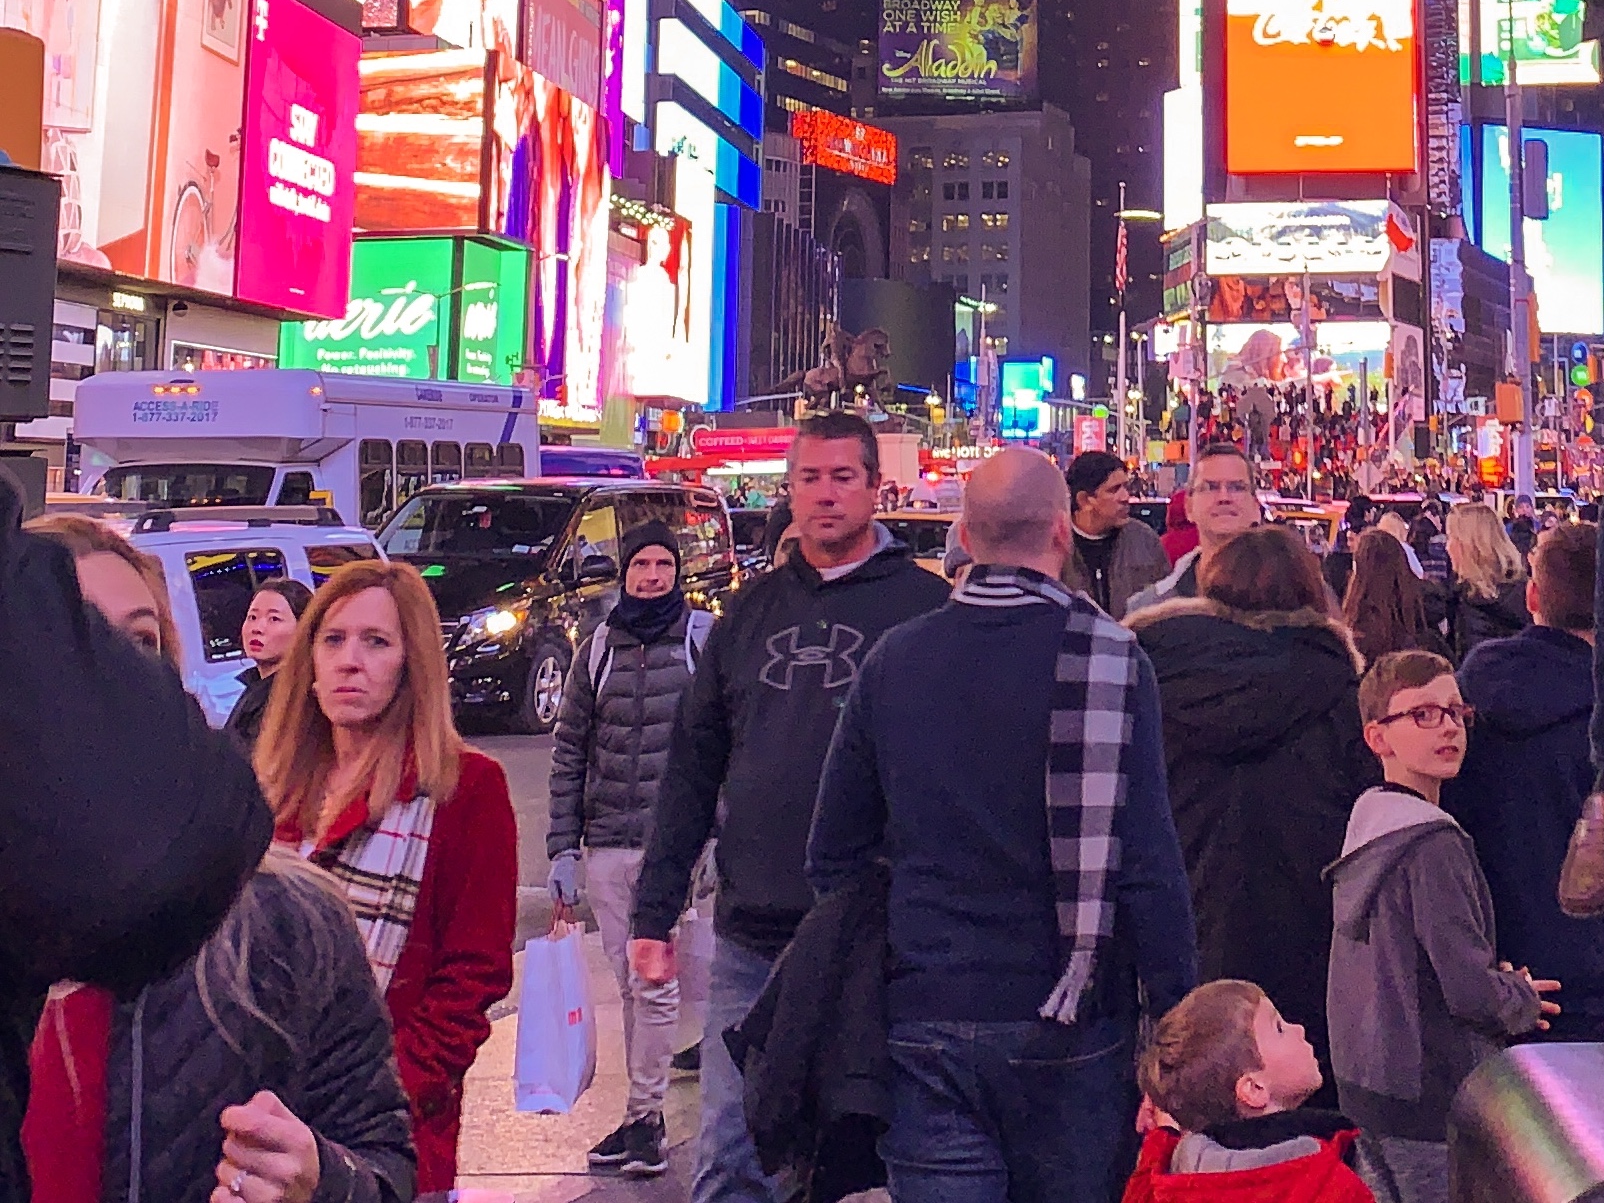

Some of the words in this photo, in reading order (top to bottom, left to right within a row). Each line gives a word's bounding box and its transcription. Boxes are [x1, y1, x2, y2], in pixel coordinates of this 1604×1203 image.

[883, 0, 960, 10] BROADWAY
[883, 9, 916, 22] ONE
[921, 9, 960, 23] WISH
[883, 22, 902, 34] AT
[905, 22, 917, 34] A
[882, 39, 998, 79] Aladdin
[133, 400, 219, 411] ACCESS-A-RIDE
[132, 412, 219, 422] 1-877-337-2017
